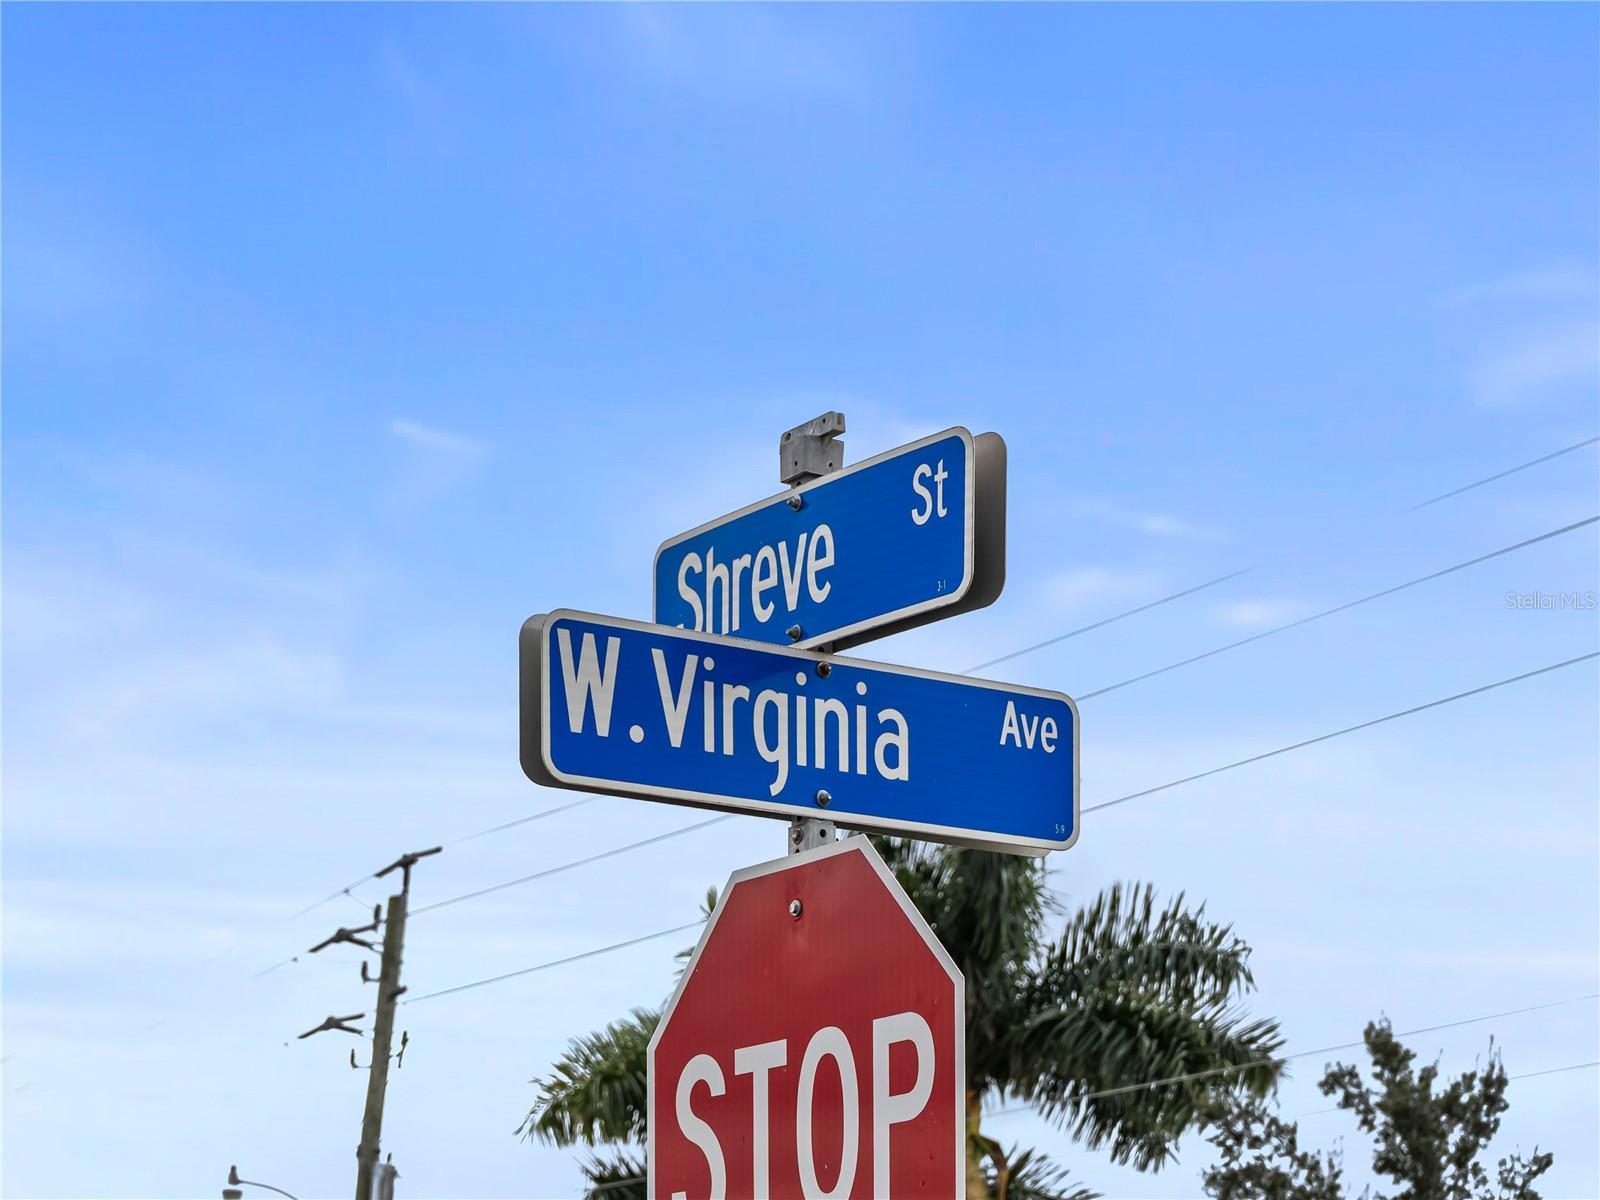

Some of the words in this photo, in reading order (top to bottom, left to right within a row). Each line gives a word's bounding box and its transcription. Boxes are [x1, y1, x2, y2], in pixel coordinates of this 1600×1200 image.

[677, 523, 835, 635] Shreve
[911, 458, 949, 526] St
[999, 700, 1058, 753] Ave
[671, 1011, 936, 1200] STOP
